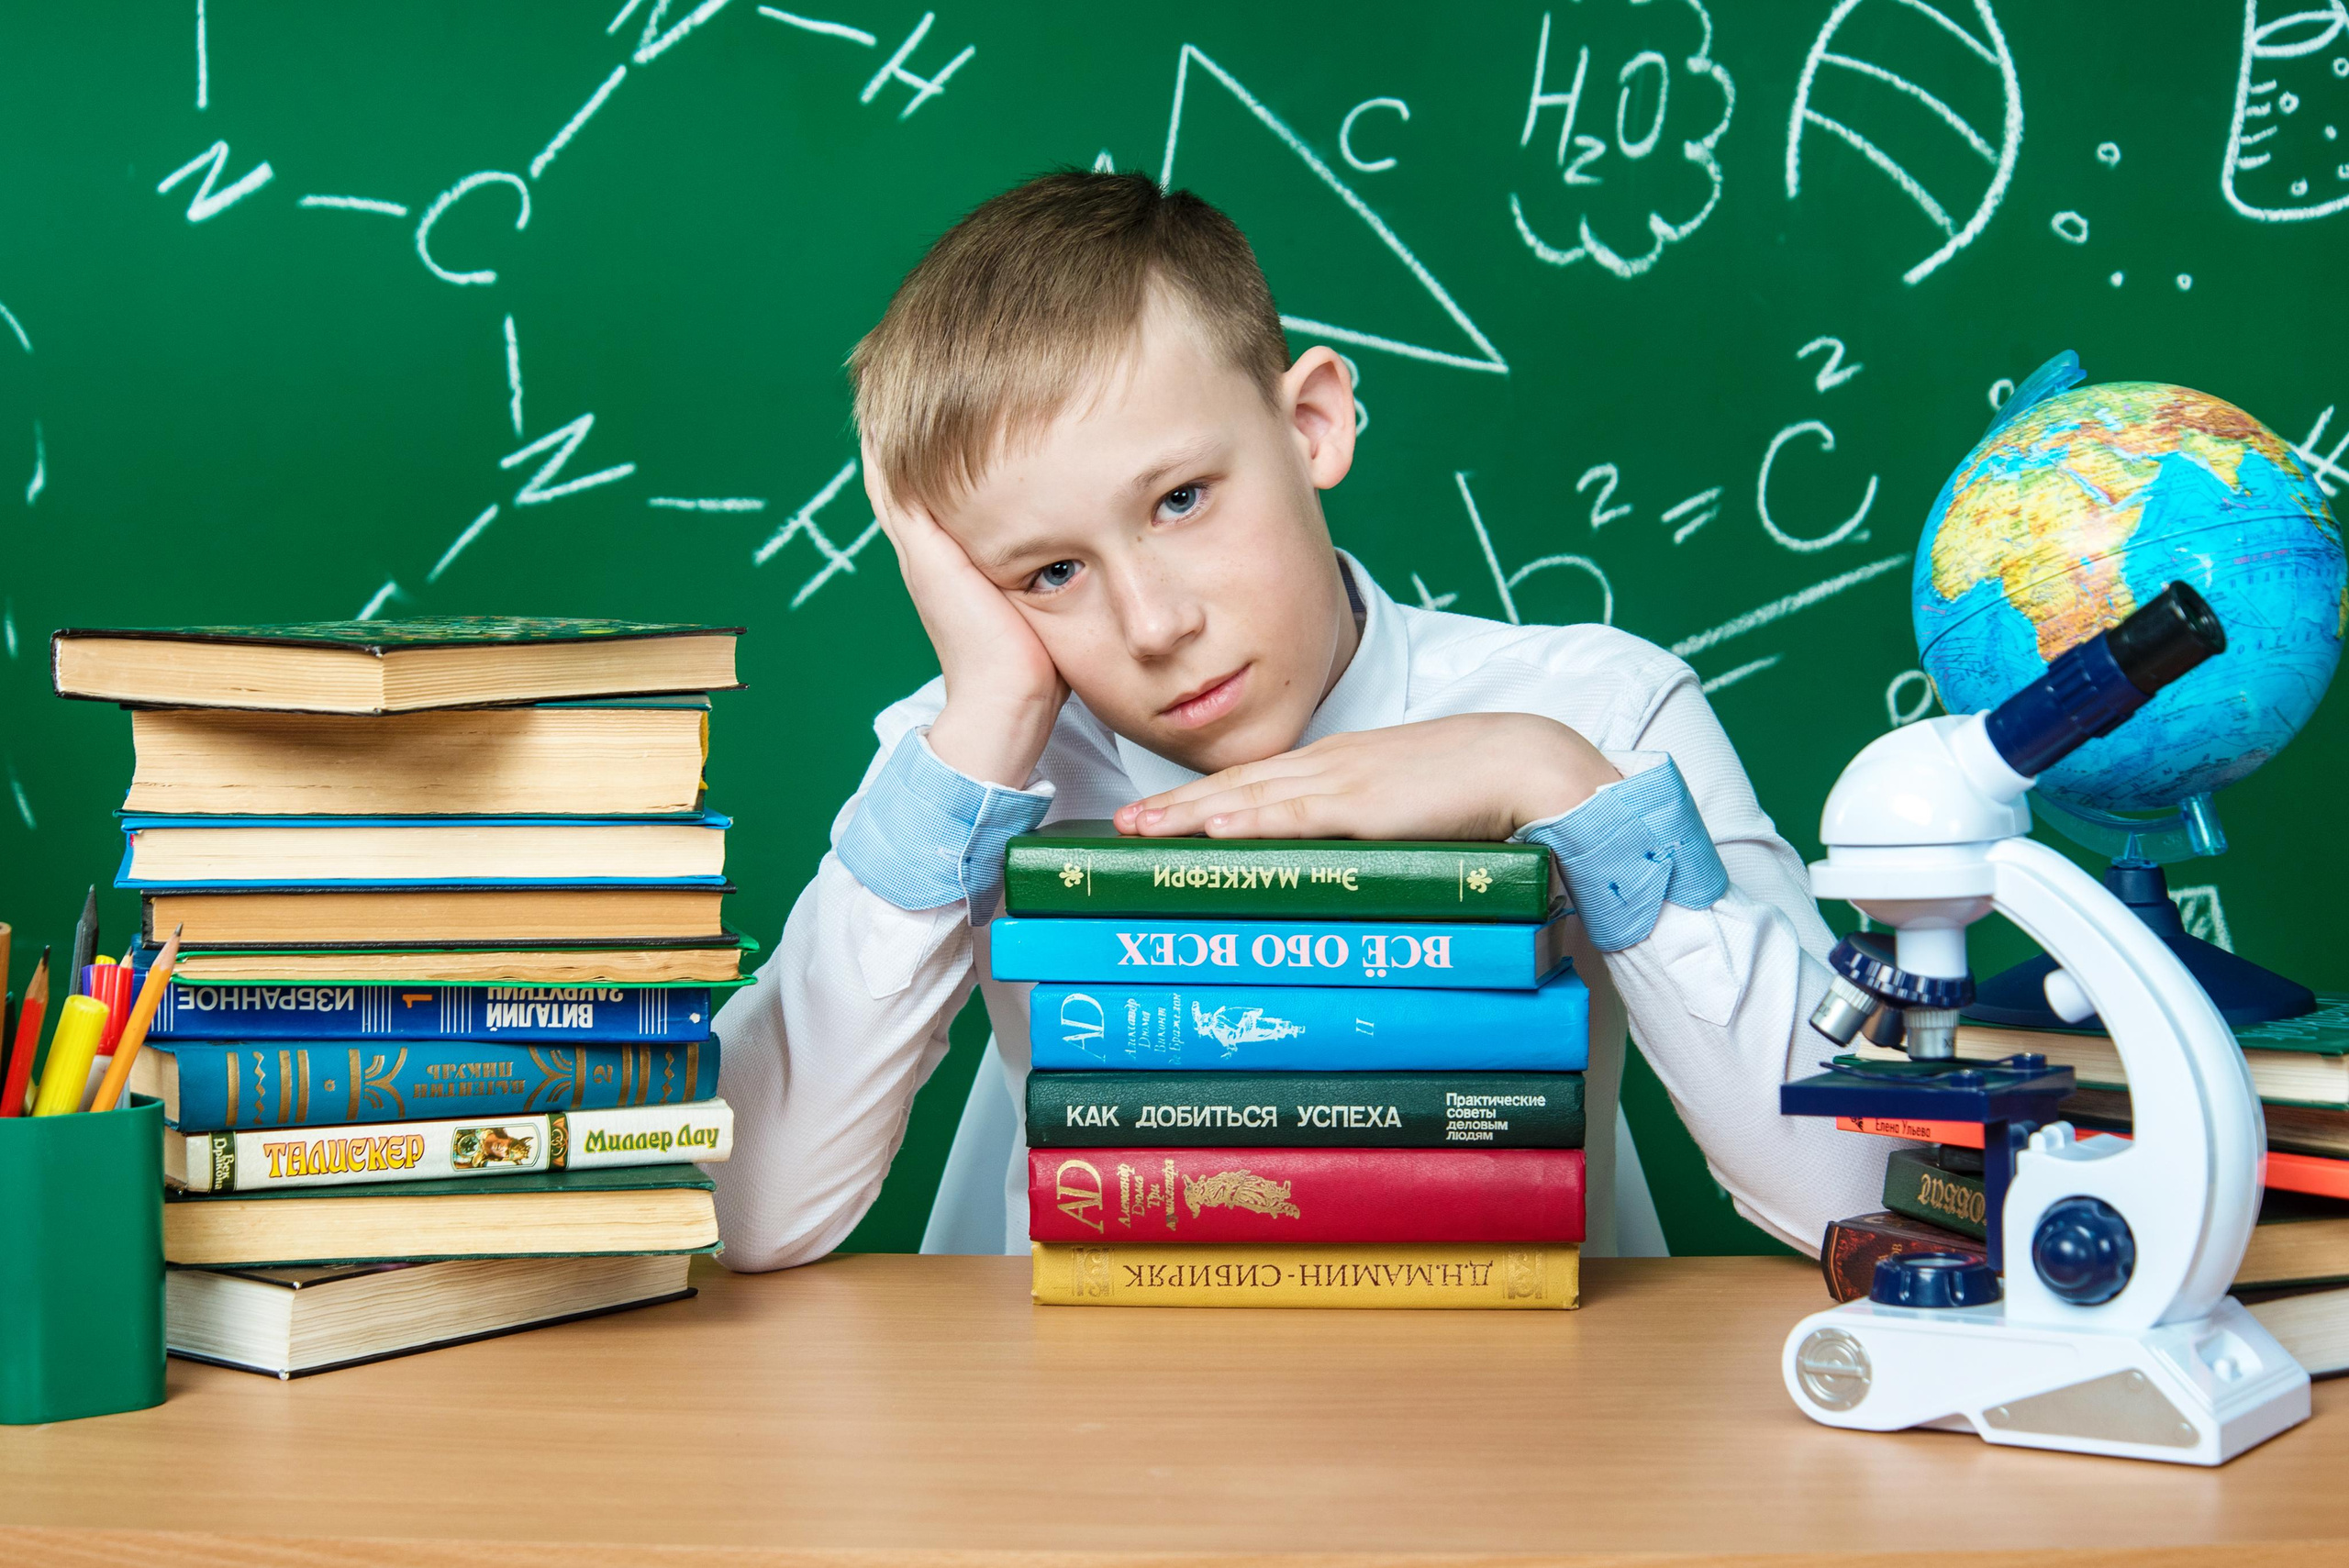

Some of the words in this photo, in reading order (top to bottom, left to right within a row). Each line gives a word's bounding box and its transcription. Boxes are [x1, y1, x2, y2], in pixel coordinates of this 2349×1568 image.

[1153, 864, 1300, 889] МАККЕФРИ
[1115, 932, 1240, 966] ВСЕХ
[1252, 934, 1350, 968] ОБО
[1362, 935, 1454, 978] ВСЁ
[177, 987, 355, 1012] ИЗБРАННОЕ
[486, 1003, 594, 1032] ВИТАЛИЙ
[426, 1061, 514, 1081] ПИКУЛЬ
[413, 1079, 526, 1099] ВАЛЕНТИН
[1446, 1092, 1546, 1107] Практические
[1066, 1105, 1119, 1128] КАК
[1135, 1105, 1278, 1129] ДОБИТЬСЯ
[1297, 1105, 1402, 1128] УСПЕХА
[1446, 1107, 1497, 1118] советы
[1445, 1119, 1508, 1131] деловым
[1445, 1130, 1494, 1141] людям
[1876, 1118, 1899, 1134] Елена
[584, 1129, 674, 1153] Миллер
[675, 1123, 720, 1149] Лау
[262, 1133, 425, 1179] ТАЛИСКЕР
[1147, 1184, 1164, 1208] Три
